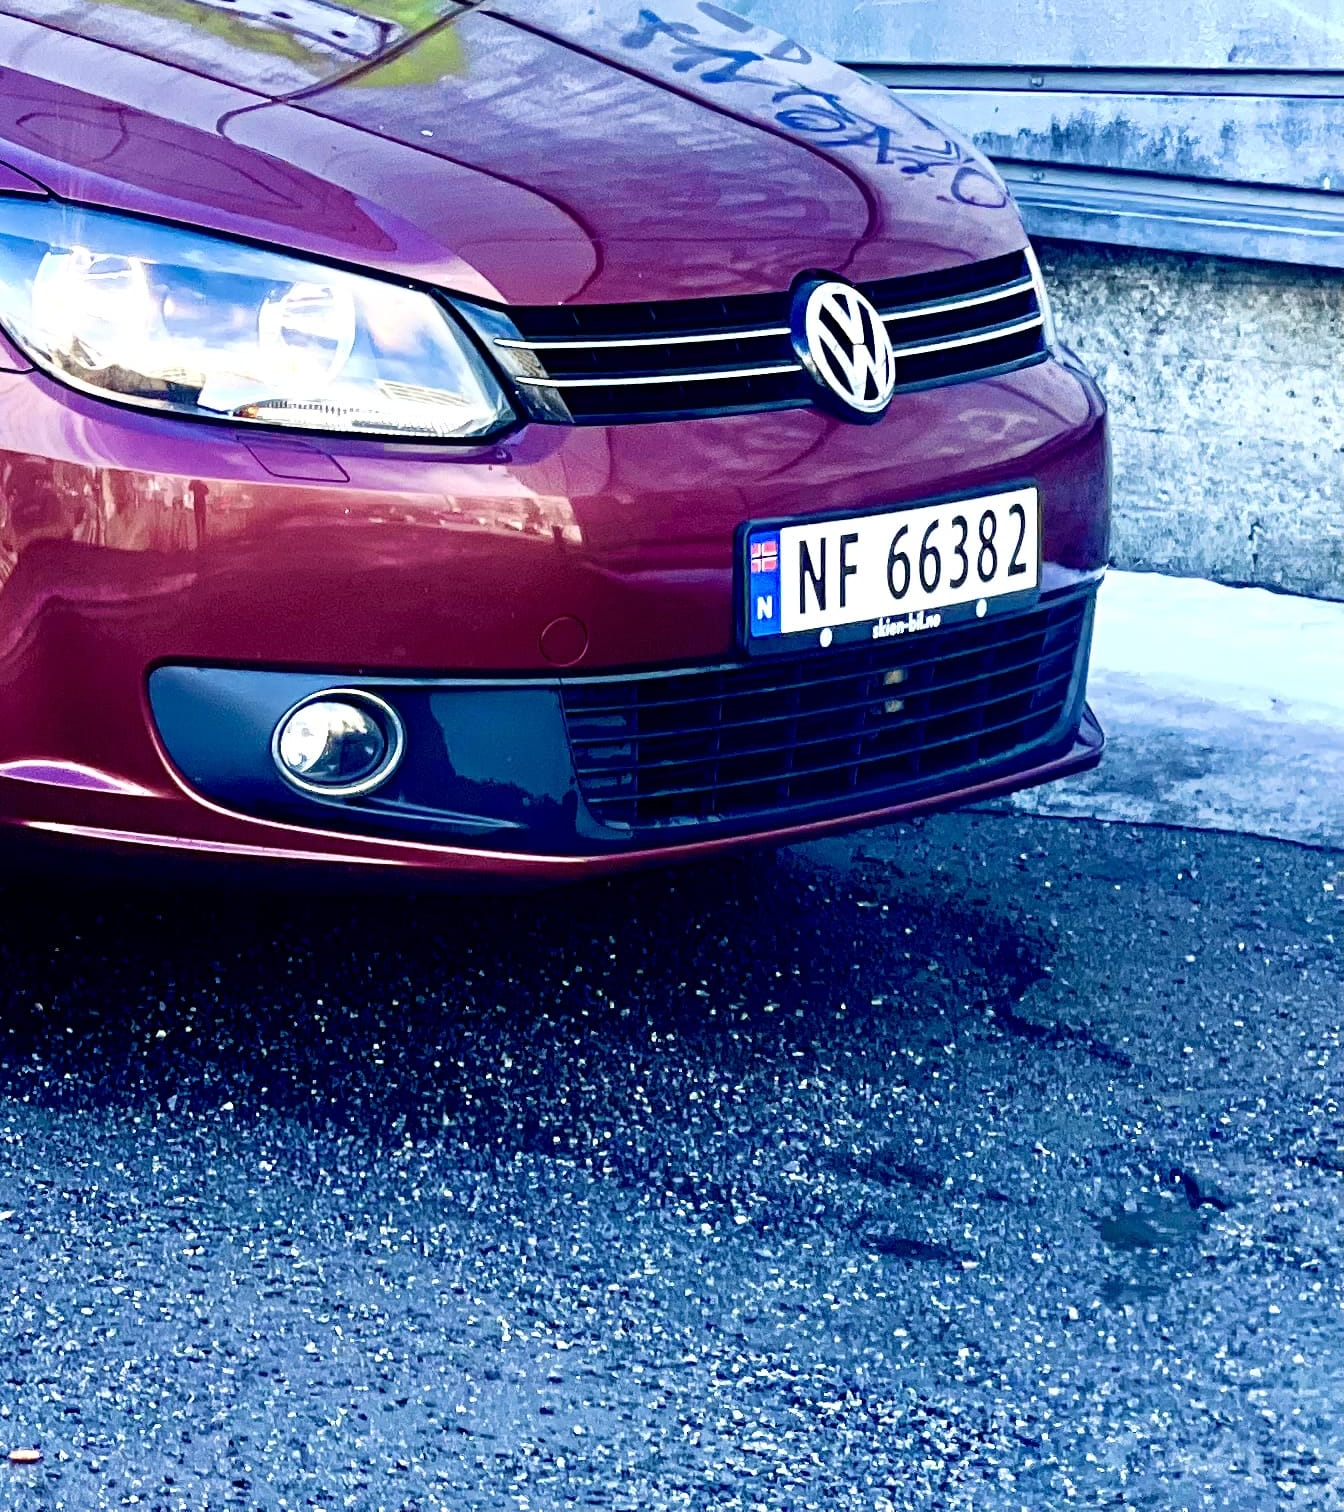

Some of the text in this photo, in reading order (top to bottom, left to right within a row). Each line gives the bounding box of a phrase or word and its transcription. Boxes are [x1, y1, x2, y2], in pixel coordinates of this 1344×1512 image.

[799, 503, 1027, 615] NF 66382
[756, 595, 774, 620] N
